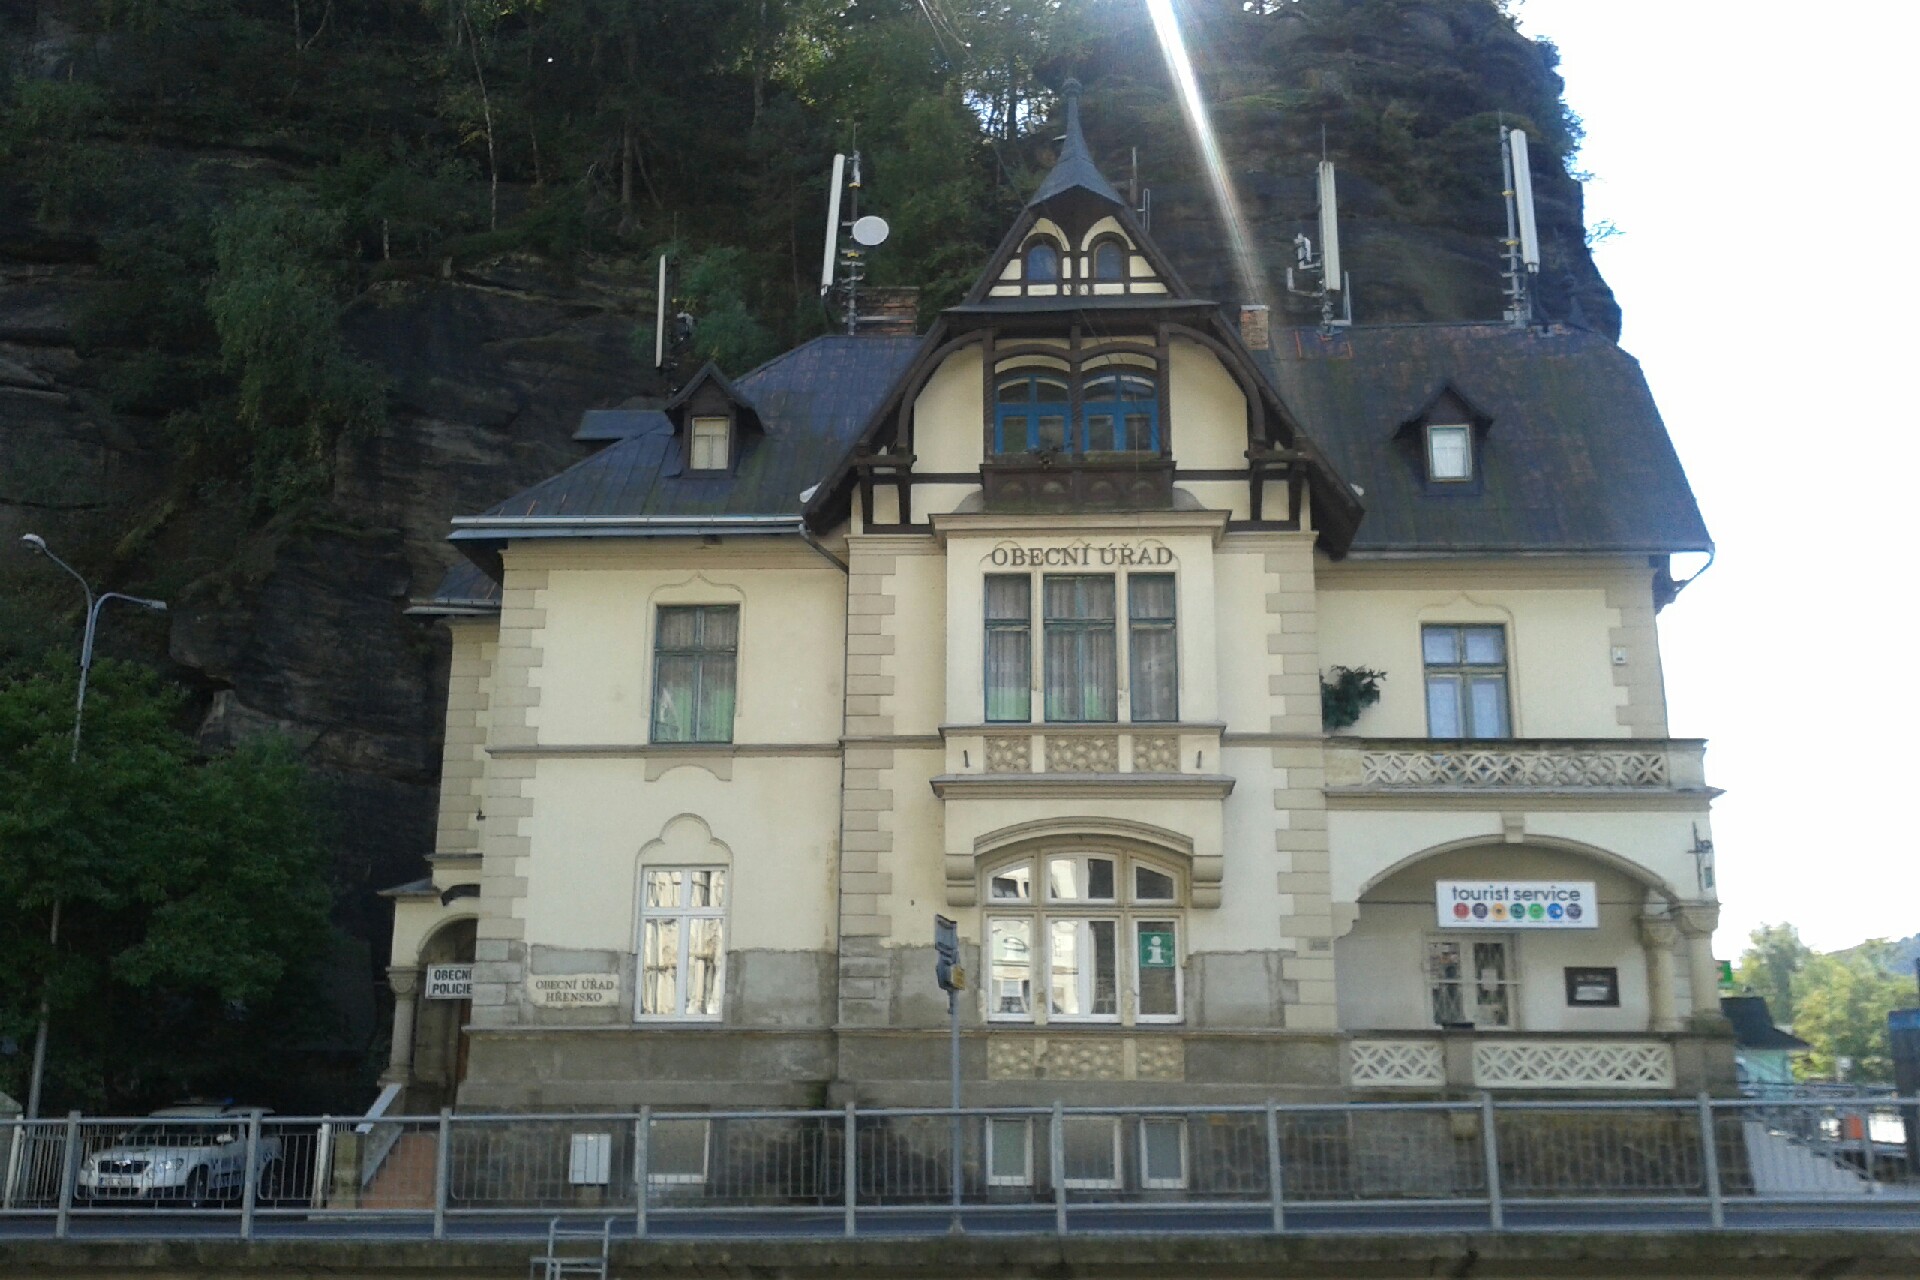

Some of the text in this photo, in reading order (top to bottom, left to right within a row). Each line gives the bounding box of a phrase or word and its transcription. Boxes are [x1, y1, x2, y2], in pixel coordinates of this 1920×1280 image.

[991, 543, 1173, 566] OBECNÍ ÚŘAD
[1452, 885, 1581, 901] tourist service
[432, 983, 473, 994] POLICIE
[535, 977, 615, 990] OBECNÍ ÚŘAD
[546, 991, 603, 1002] HŘENSKO
